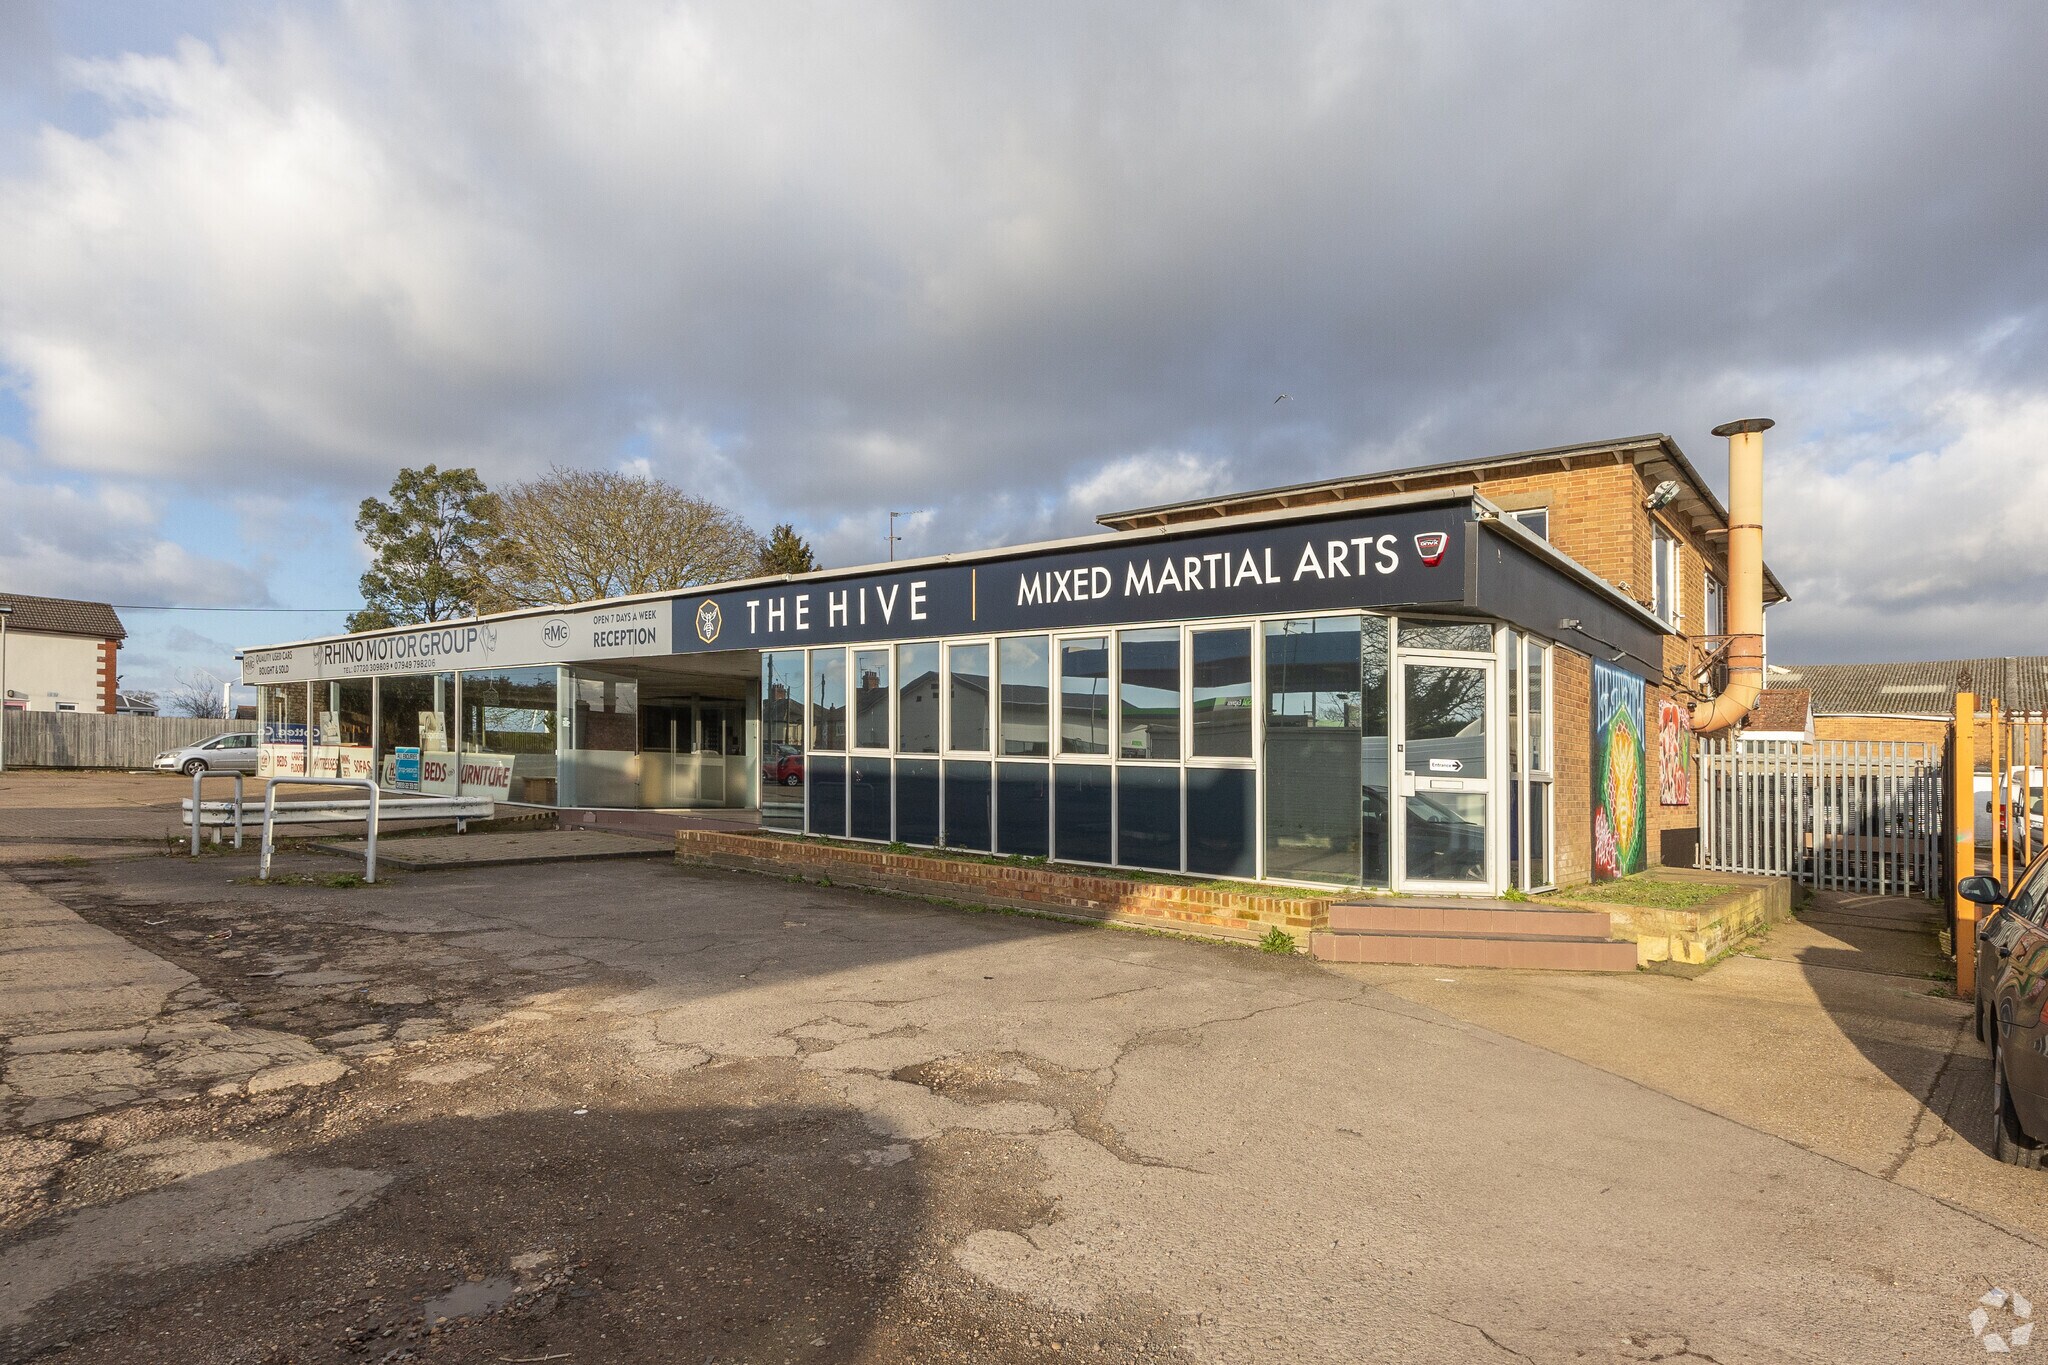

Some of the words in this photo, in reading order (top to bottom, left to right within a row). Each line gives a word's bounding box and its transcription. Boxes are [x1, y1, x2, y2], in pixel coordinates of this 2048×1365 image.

[1017, 566, 1112, 606] MIXED
[1124, 547, 1280, 597] MARTIAL
[1293, 534, 1400, 582] ARTS
[746, 594, 809, 634] THE
[829, 581, 927, 628] HIVE
[593, 615, 609, 625] OPEN
[611, 614, 615, 623] 7
[616, 612, 631, 623] DAYS
[632, 612, 637, 621] A
[639, 610, 657, 620] WEEK
[544, 625, 568, 641] RMG
[593, 627, 656, 648] RECEPTION
[325, 641, 364, 665] RHINO
[367, 635, 416, 660] MOTOR
[419, 627, 477, 657] GROUP
[256, 653, 271, 664] QUALITY
[272, 652, 282, 661] USED
[283, 651, 293, 660] CARS
[259, 666, 274, 675] BOUGHT
[275, 665, 279, 674] &
[279, 665, 289, 673] SOLD
[353, 664, 369, 673] 07720
[394, 660, 412, 670] 07949
[276, 755, 287, 767] BEDS
[353, 760, 372, 773] SOFAS
[424, 762, 447, 782] BEDS
[461, 764, 510, 788] URNITURE
